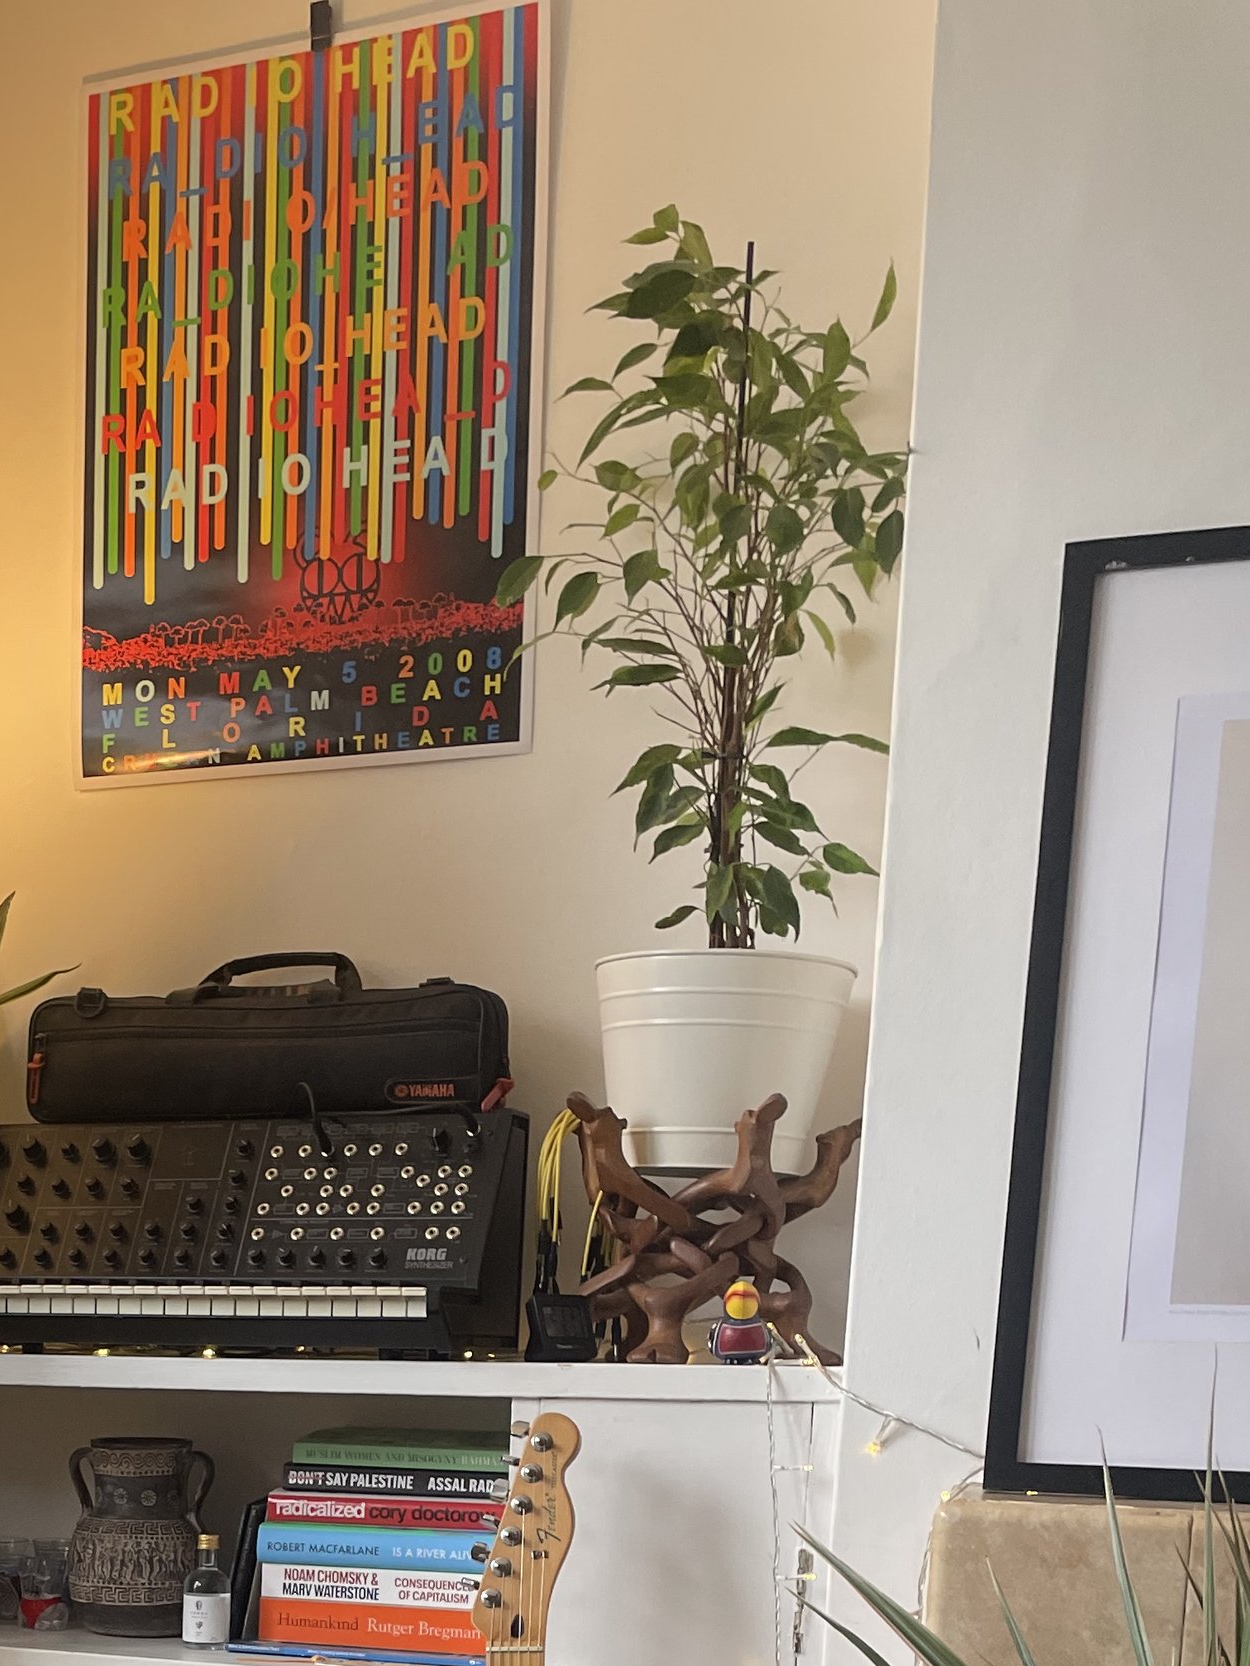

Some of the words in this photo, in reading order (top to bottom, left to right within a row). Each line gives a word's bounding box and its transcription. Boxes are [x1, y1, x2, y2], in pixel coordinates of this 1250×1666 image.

[103, 677, 185, 706] MON
[219, 666, 301, 695] MAY
[342, 660, 357, 684] 5
[398, 646, 502, 679] 2008
[102, 700, 201, 730] WEST
[230, 689, 330, 718] PALM
[361, 674, 502, 706] BEACH
[247, 723, 500, 761] AMPHITHEATRE
[409, 1083, 455, 1097] YAMAHA
[406, 1248, 447, 1261] KORG
[306, 1449, 342, 1460] MUSLIM
[344, 1450, 381, 1461] WOMEN
[384, 1452, 405, 1462] AND
[461, 1455, 502, 1467] RAHMA
[288, 1470, 325, 1486] DON'T
[326, 1472, 349, 1487] SAY
[350, 1473, 414, 1490] PALESTINE
[427, 1477, 467, 1492] ASSAL
[275, 1500, 366, 1519] radicalized
[369, 1506, 407, 1523] cory
[536, 1497, 562, 1544] Fender
[267, 1541, 306, 1552] ROBERT
[308, 1544, 380, 1556] MACFARLANE
[392, 1547, 403, 1557] IS
[405, 1548, 413, 1558] A
[416, 1548, 446, 1560] RIVER
[450, 1549, 472, 1561] ALIV
[284, 1568, 315, 1583] NOAM
[317, 1570, 369, 1585] CHOMSKY
[370, 1573, 379, 1586] &
[282, 1582, 313, 1597] MARV
[314, 1584, 380, 1601] WATERSTONE
[398, 1590, 411, 1601] OF
[412, 1591, 469, 1604] CAPITALISM
[277, 1612, 359, 1631] Humankind
[366, 1616, 415, 1637] Rutger
[418, 1620, 481, 1640] Bregman
